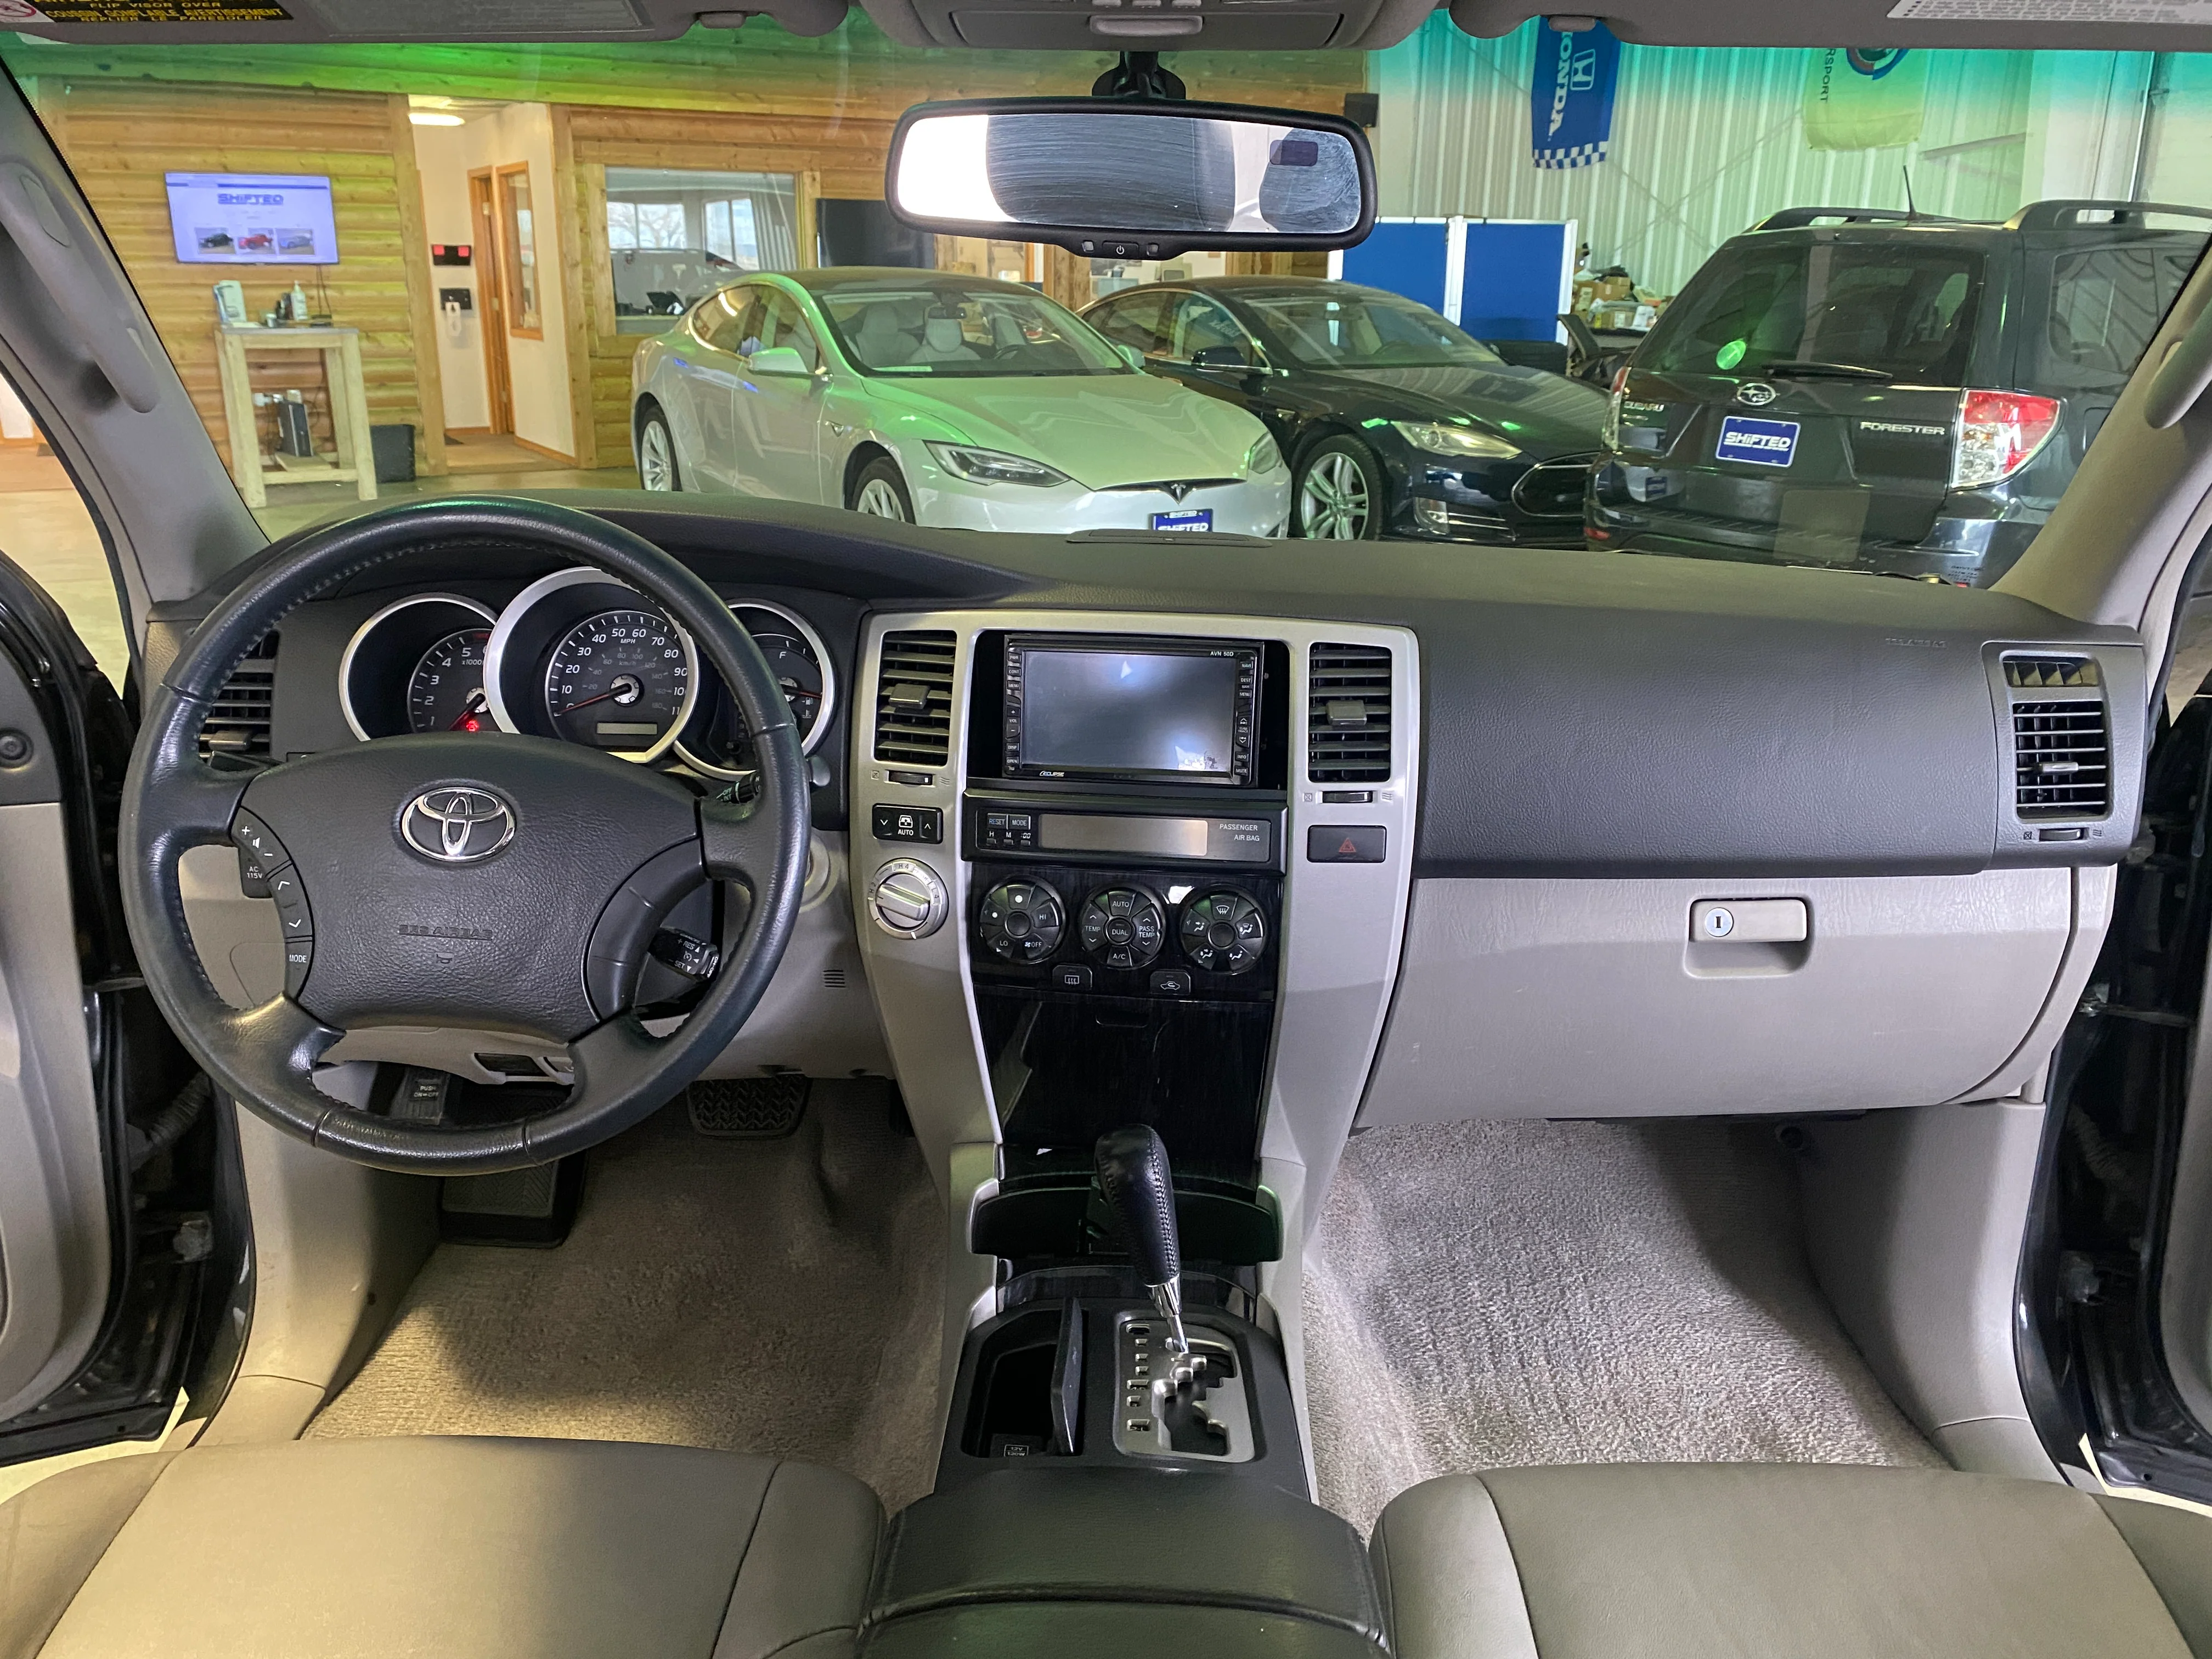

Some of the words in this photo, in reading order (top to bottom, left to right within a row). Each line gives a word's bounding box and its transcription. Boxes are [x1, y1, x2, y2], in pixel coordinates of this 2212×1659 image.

[1859, 421, 1945, 435] FORESTER
[612, 628, 625, 637] 50
[632, 629, 646, 637] 60
[592, 634, 606, 643] 40
[651, 637, 664, 646] 70
[461, 647, 471, 657] 5
[577, 647, 591, 656] 30
[664, 650, 678, 658] 80
[442, 658, 452, 667] 4
[566, 665, 580, 674] 20
[674, 668, 687, 676] 90
[430, 675, 439, 685] 3
[561, 685, 572, 693] 10
[674, 687, 686, 696] 10
[425, 696, 434, 705] 2
[431, 716, 435, 726] 1
[683, 941, 695, 950] RES
[289, 954, 307, 963] MODE
[675, 960, 685, 969] SET
